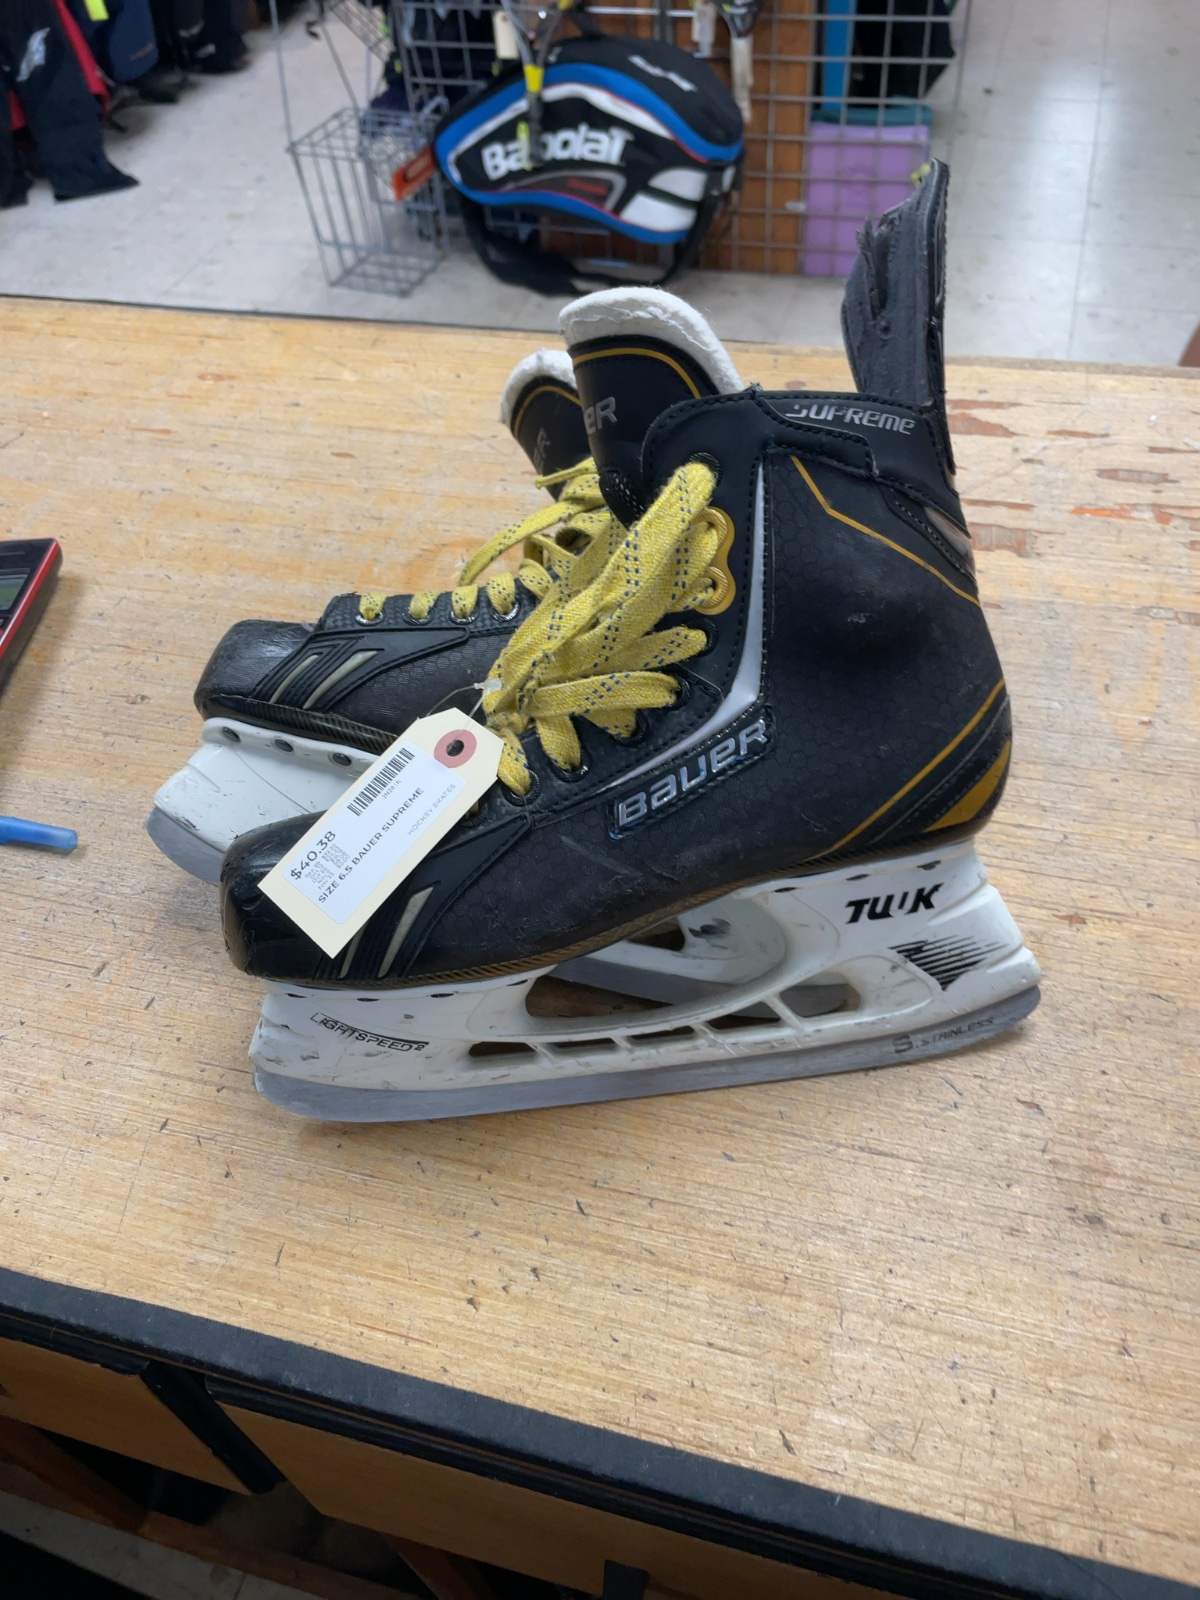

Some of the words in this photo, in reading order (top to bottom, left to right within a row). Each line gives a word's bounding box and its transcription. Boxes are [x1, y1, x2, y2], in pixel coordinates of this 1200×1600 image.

[406, 806, 434, 836] HOCKEY
[431, 782, 456, 809] SKATES
[290, 830, 337, 881] $40.38
[317, 879, 340, 903] SIZE
[337, 864, 353, 881] 6.5
[351, 830, 383, 866] BAUER
[380, 786, 424, 833] SUPREME
